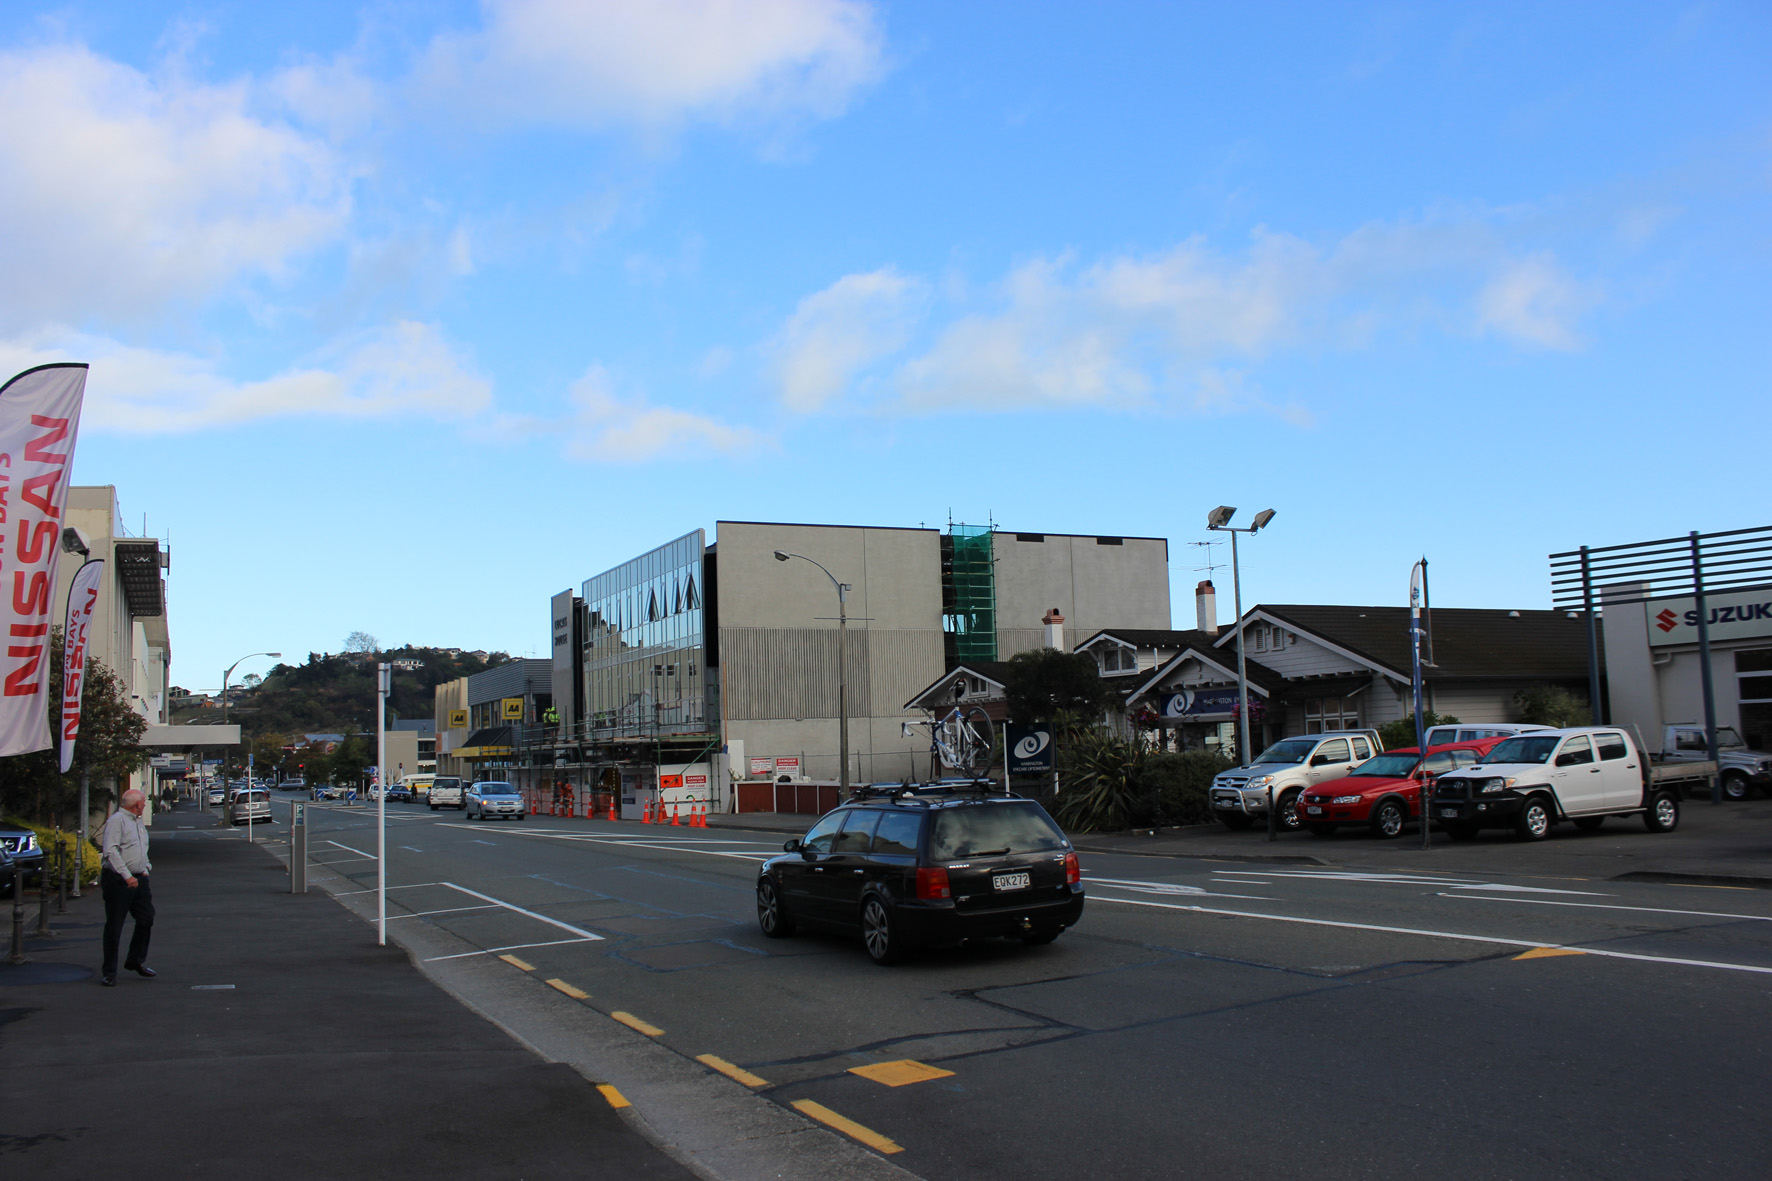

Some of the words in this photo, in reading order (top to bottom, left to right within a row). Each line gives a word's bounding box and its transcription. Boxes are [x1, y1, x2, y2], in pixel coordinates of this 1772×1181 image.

[4, 414, 69, 697] NISSAN
[67, 609, 80, 649] BAYS
[63, 587, 98, 741] NISSAN
[508, 704, 519, 713] AA
[994, 874, 1029, 888] EQK272
